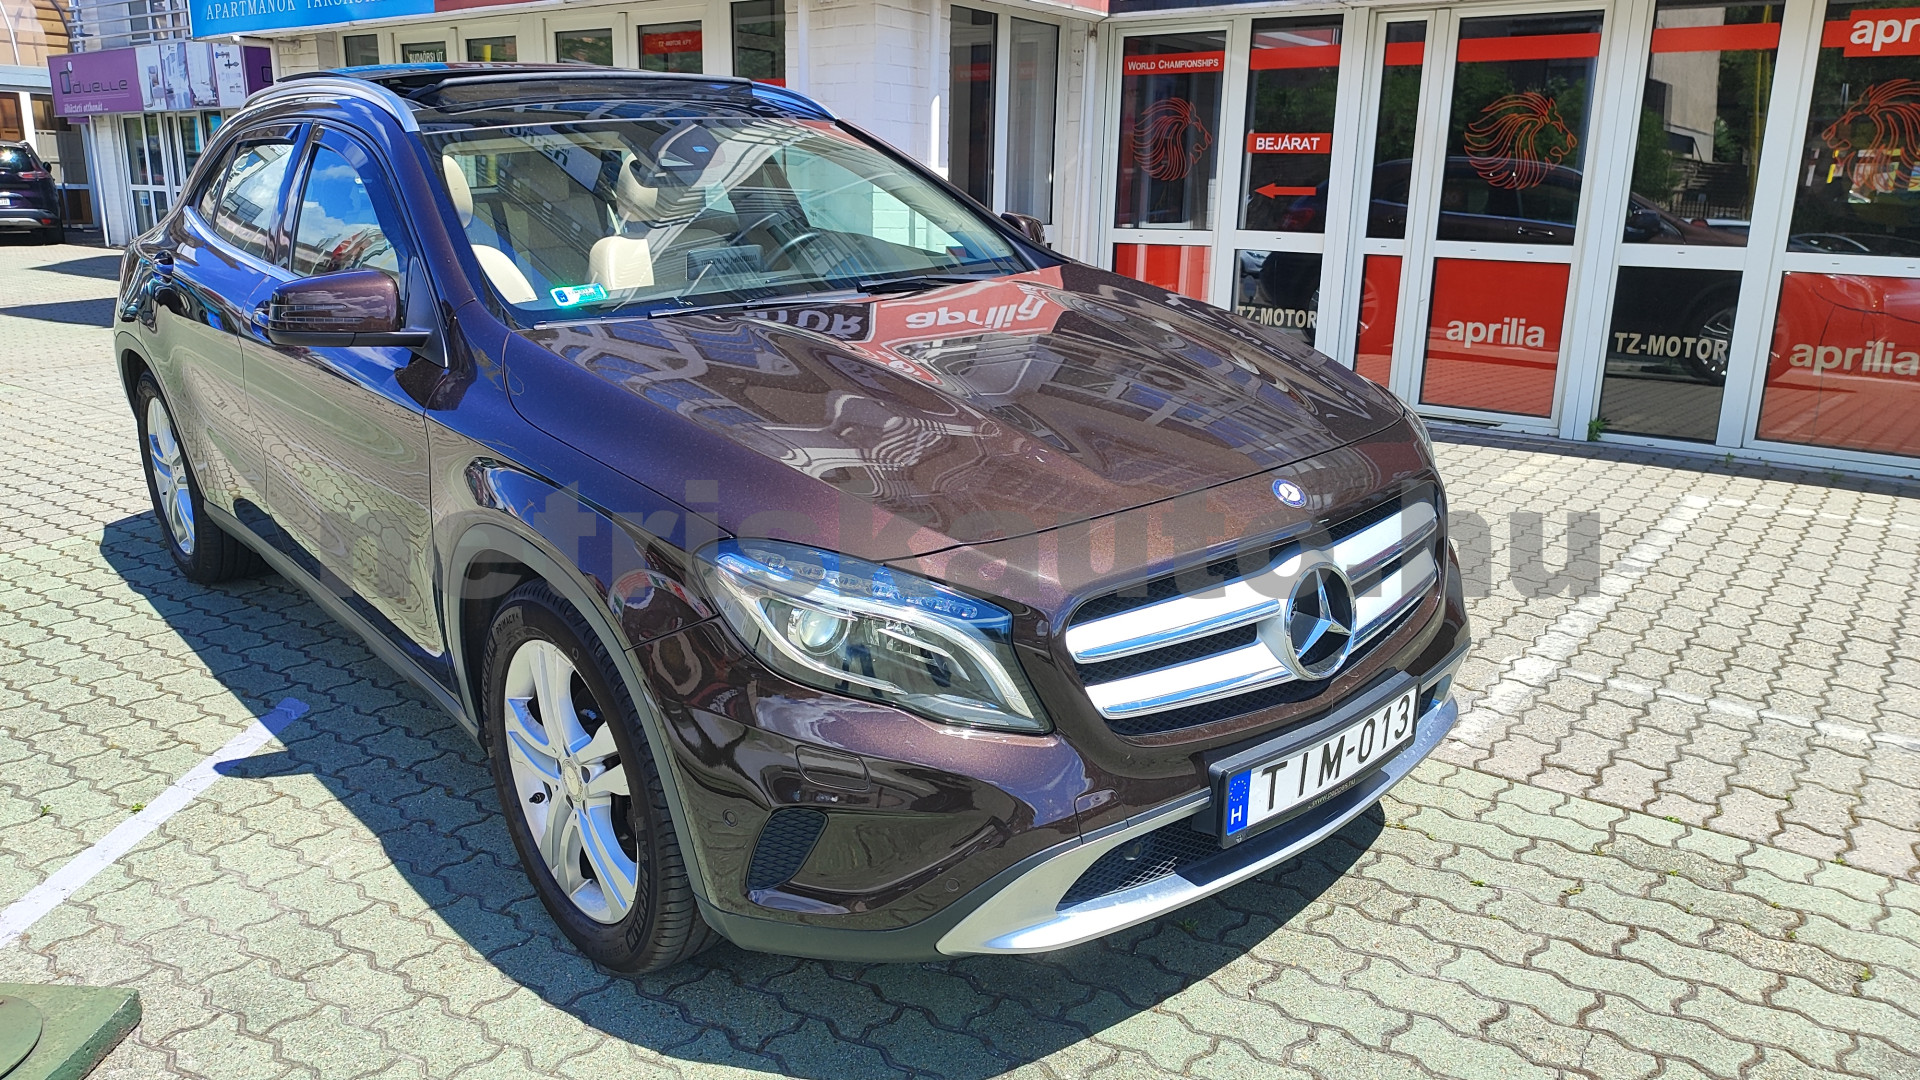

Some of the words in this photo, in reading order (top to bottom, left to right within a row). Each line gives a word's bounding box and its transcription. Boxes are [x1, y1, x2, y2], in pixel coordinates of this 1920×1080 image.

[206, 0, 296, 20] APARTMANOK
[1850, 17, 1920, 51] apr
[1256, 134, 1320, 151] BEJÁRAT
[1446, 317, 1546, 349] aprilia
[1614, 331, 1729, 361] TZ-MOTOR
[1789, 340, 1920, 376] aprilia
[1261, 694, 1410, 810] TIM-013
[1230, 804, 1243, 826] H
